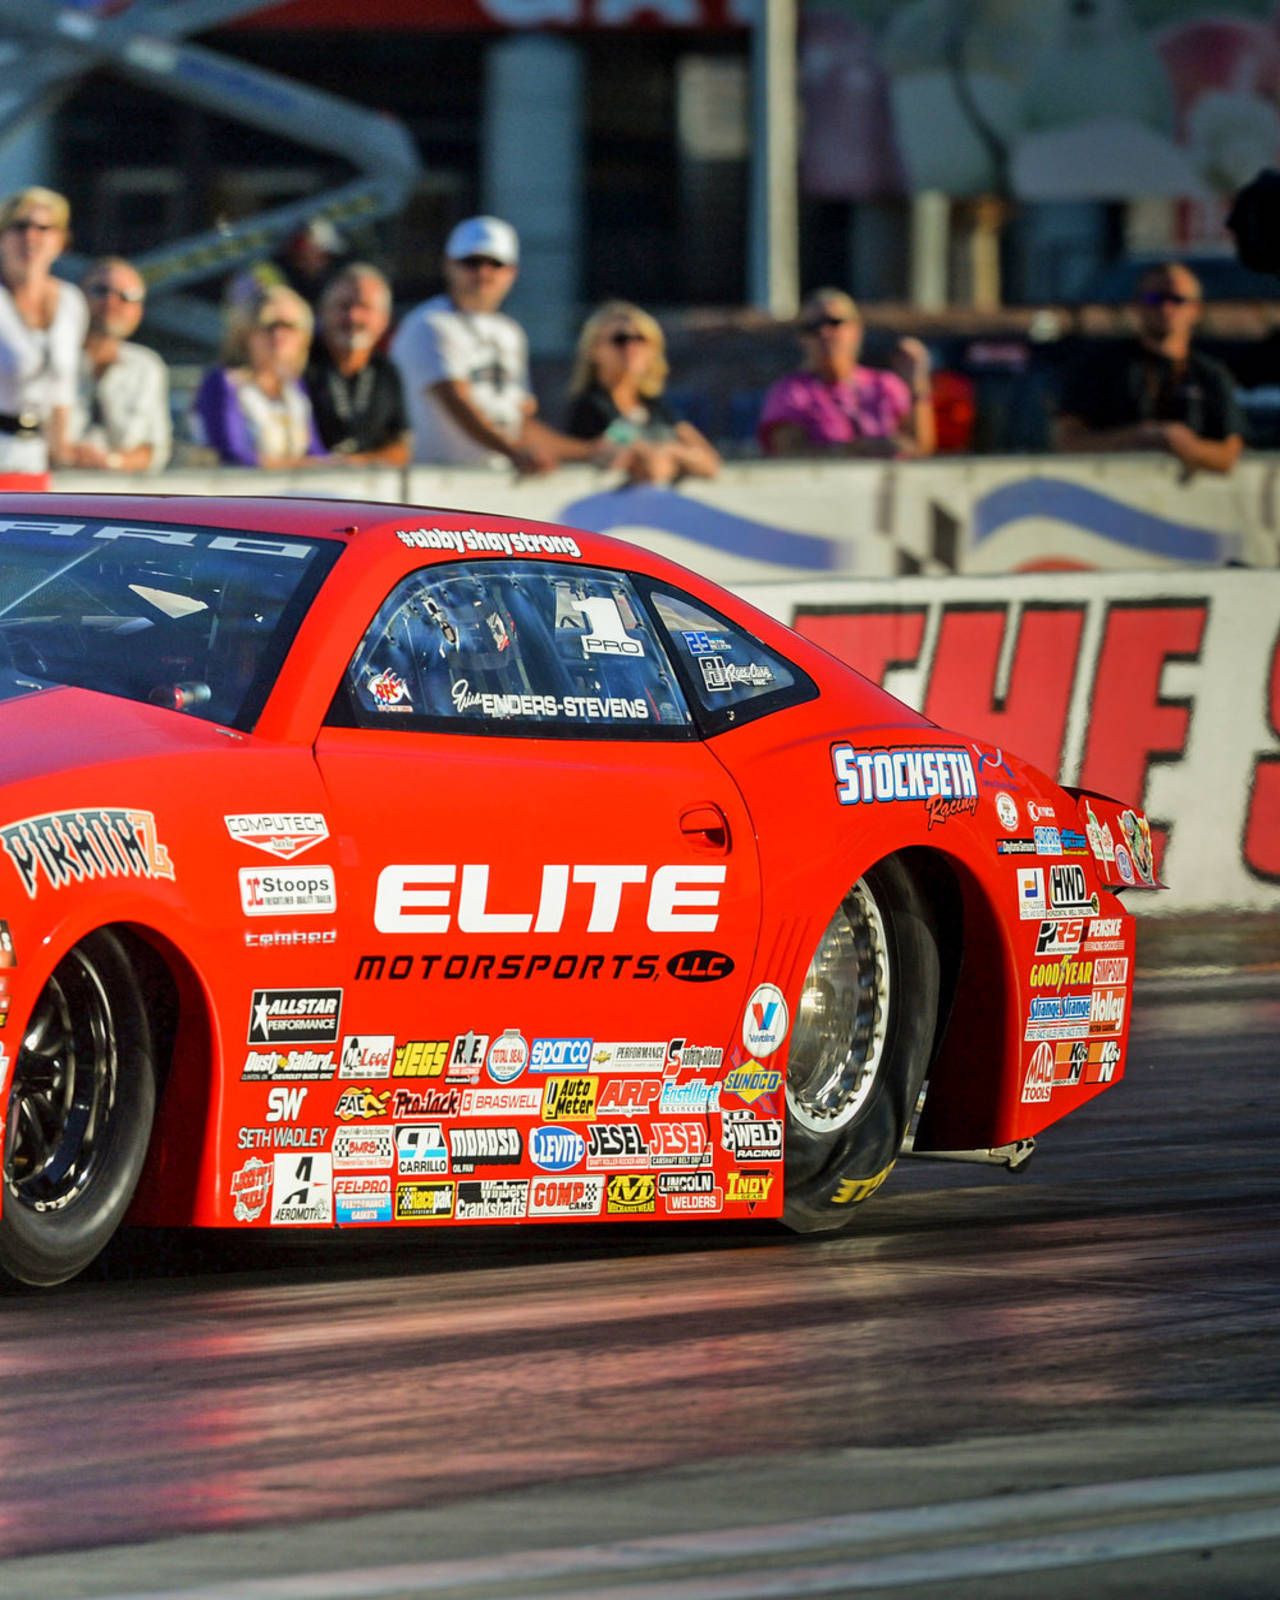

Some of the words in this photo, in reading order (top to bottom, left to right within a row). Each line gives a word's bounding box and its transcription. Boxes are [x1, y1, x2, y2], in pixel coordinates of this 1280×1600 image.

[586, 639, 639, 653] PRO
[482, 694, 649, 719] ENDERS-STEVENS
[834, 745, 976, 803] STOCKSETH
[226, 816, 325, 832] COMPUTECH
[263, 877, 329, 894] Stoops
[1053, 866, 1085, 901] HWD
[374, 864, 727, 934] ELITE
[1088, 919, 1122, 937] PENSKE
[674, 956, 726, 977] LLC
[270, 999, 337, 1014] ALLSTAR
[1091, 991, 1124, 1030] Holley
[269, 1018, 336, 1030] PERFORMANCE
[393, 1042, 450, 1077] JEGS
[532, 1039, 592, 1068] sparco
[616, 1046, 665, 1059] PERFORMANCE
[559, 1079, 591, 1097] Auto
[725, 1074, 779, 1089] SUNOCO
[475, 1094, 538, 1109] BRASWELL
[600, 1081, 660, 1106] ARP
[1025, 1087, 1050, 1100] TOOLS
[266, 1088, 308, 1122] SW
[557, 1100, 594, 1116] Meter
[238, 1128, 271, 1149] SETH
[274, 1127, 328, 1147] WADLEY
[450, 1129, 520, 1156] MOROSO
[588, 1125, 648, 1156] JESEL
[651, 1124, 711, 1154] JESEL
[736, 1121, 781, 1146] WELD
[529, 1128, 586, 1163] CLEVITE
[737, 1149, 780, 1158] RACING
[399, 1161, 446, 1173] CARRILLO
[335, 1180, 388, 1194] FEL-PRO
[481, 1182, 527, 1200] Winberg
[660, 1175, 711, 1192] LINCOLN
[725, 1173, 773, 1200] INDY
[534, 1181, 584, 1206] COMP
[672, 1196, 716, 1209] WELDERS
[456, 1199, 526, 1219] Crankshafts
[568, 1201, 594, 1210] CAMS
